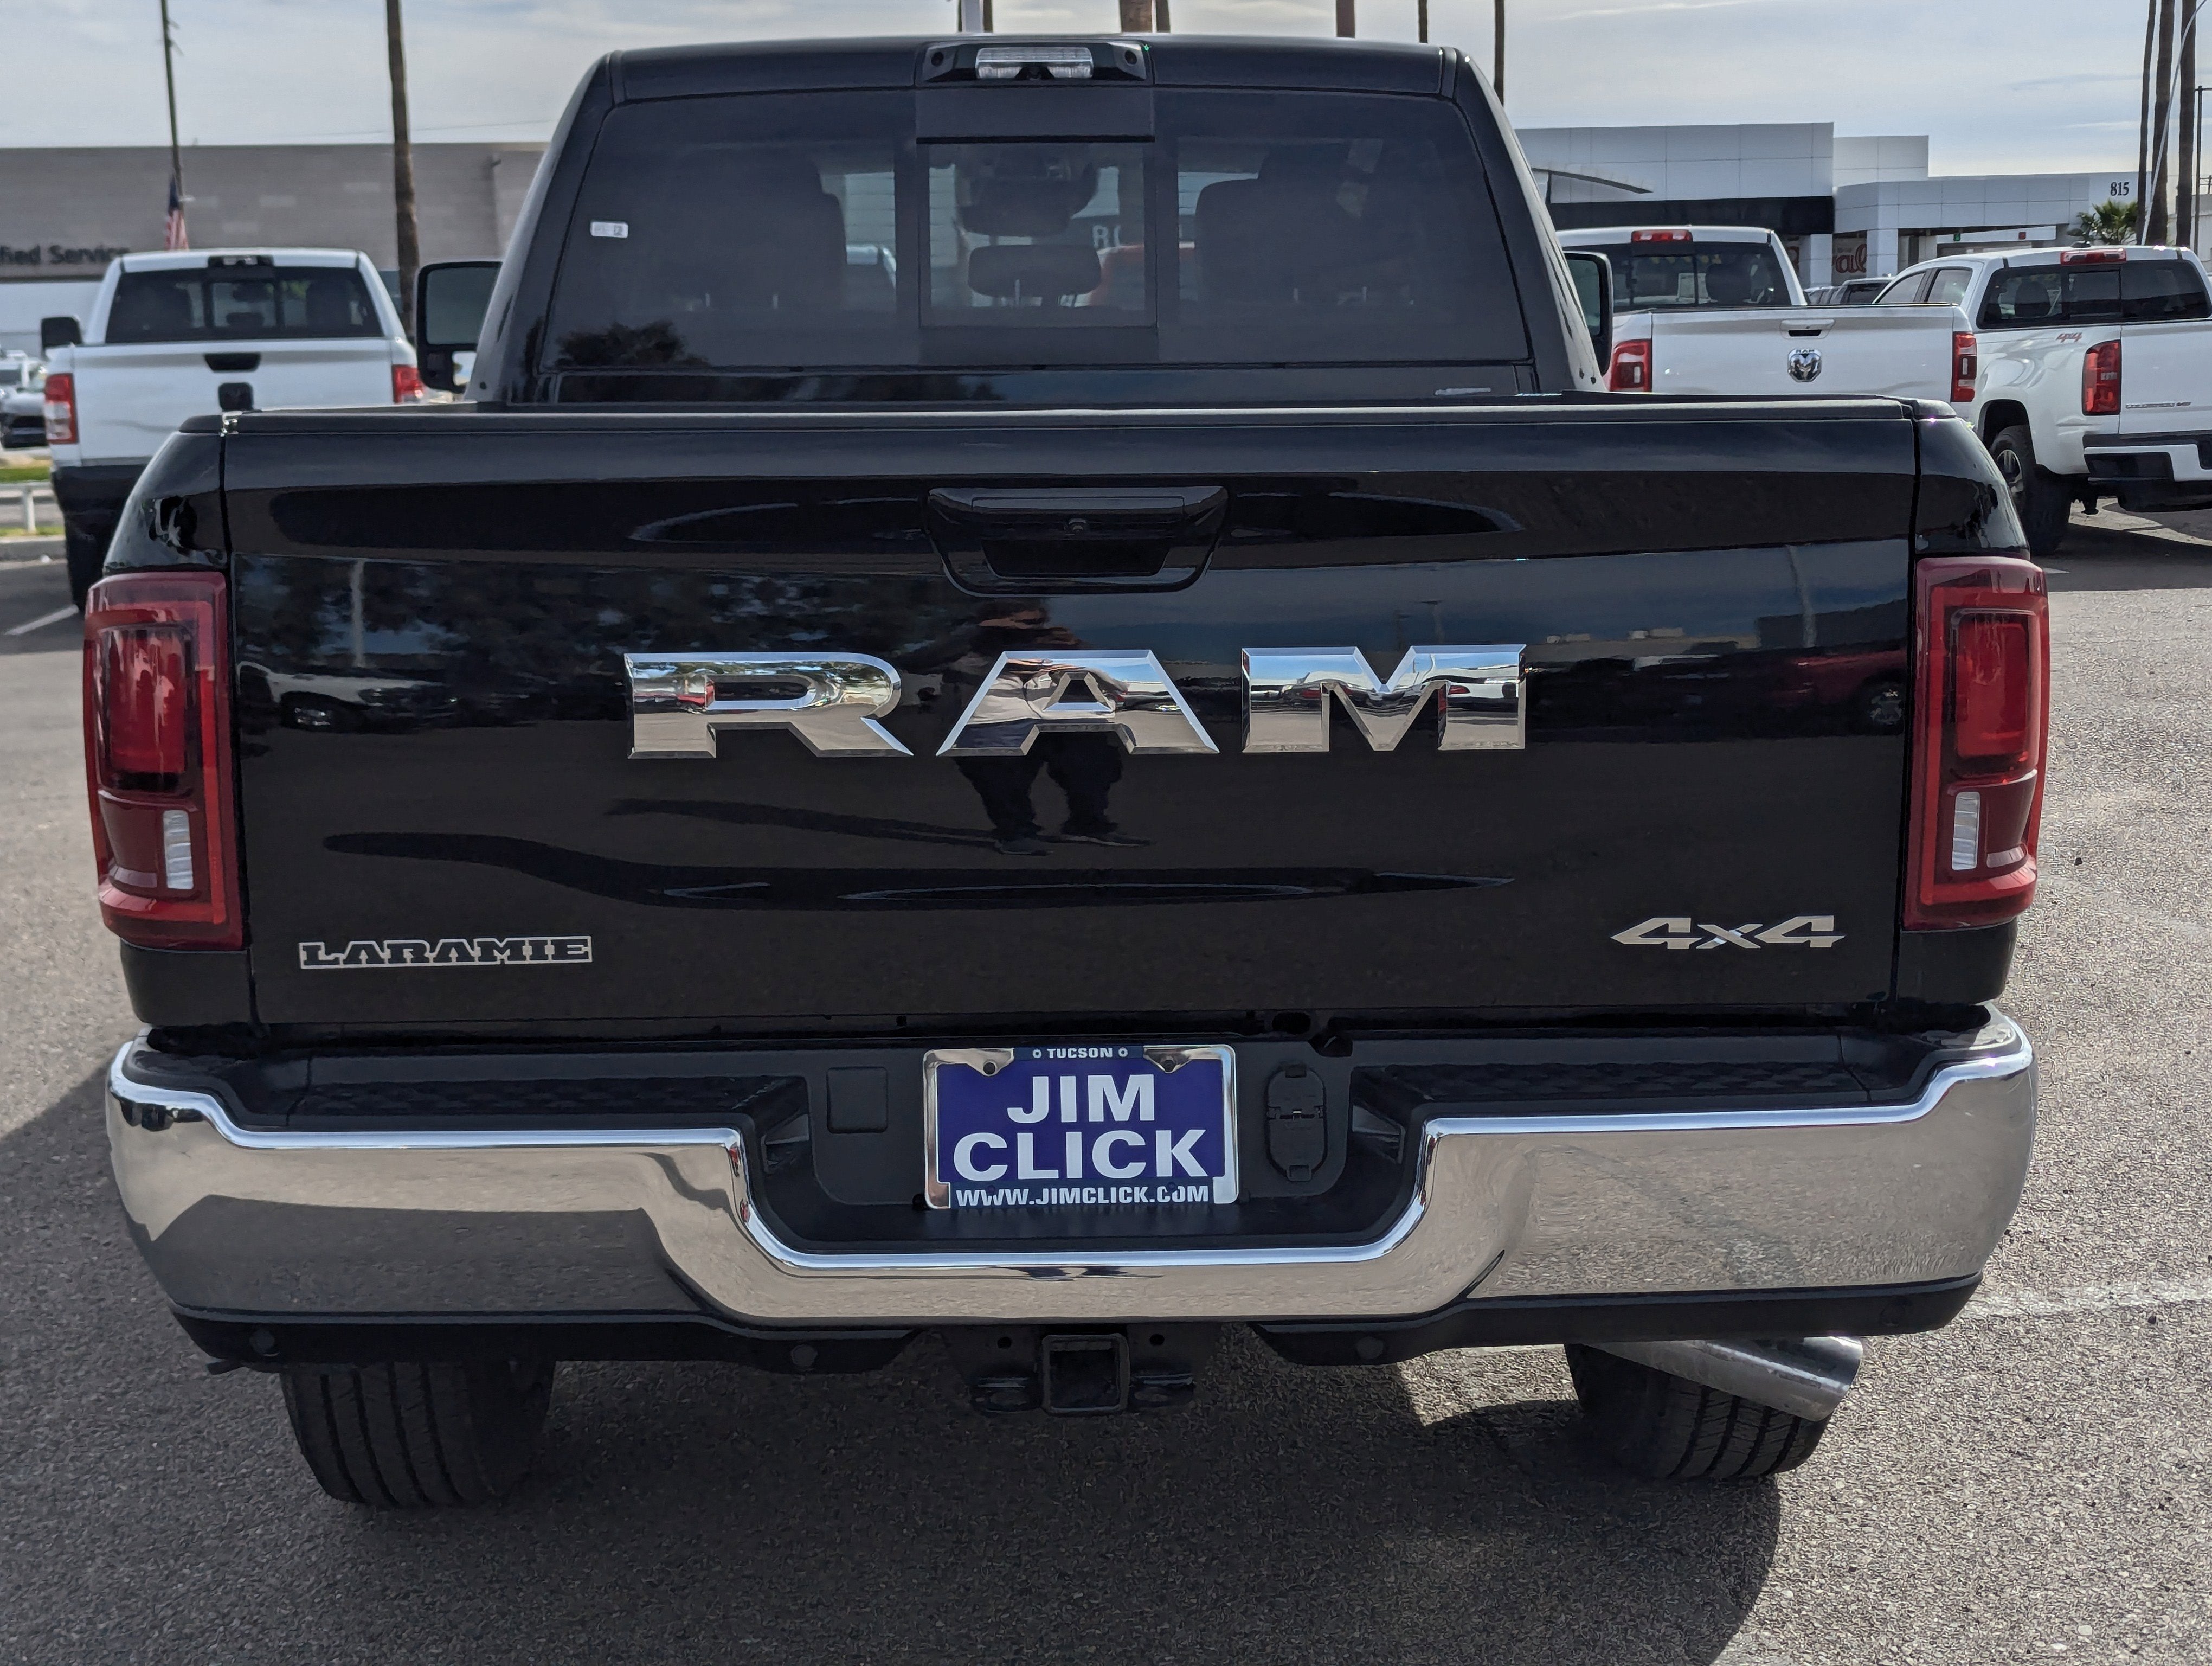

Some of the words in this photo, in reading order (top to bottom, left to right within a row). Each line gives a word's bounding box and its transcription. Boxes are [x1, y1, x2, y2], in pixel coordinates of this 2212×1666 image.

[2110, 182, 2130, 196] 815
[625, 644, 1527, 760] RAM
[298, 935, 593, 970] LARAMIE
[1047, 1047, 1113, 1059] TUCSON
[1007, 1074, 1155, 1123] JIM
[953, 1129, 1208, 1181] CLICK
[956, 1185, 1209, 1207] WWW.JIMCLICK.COM
